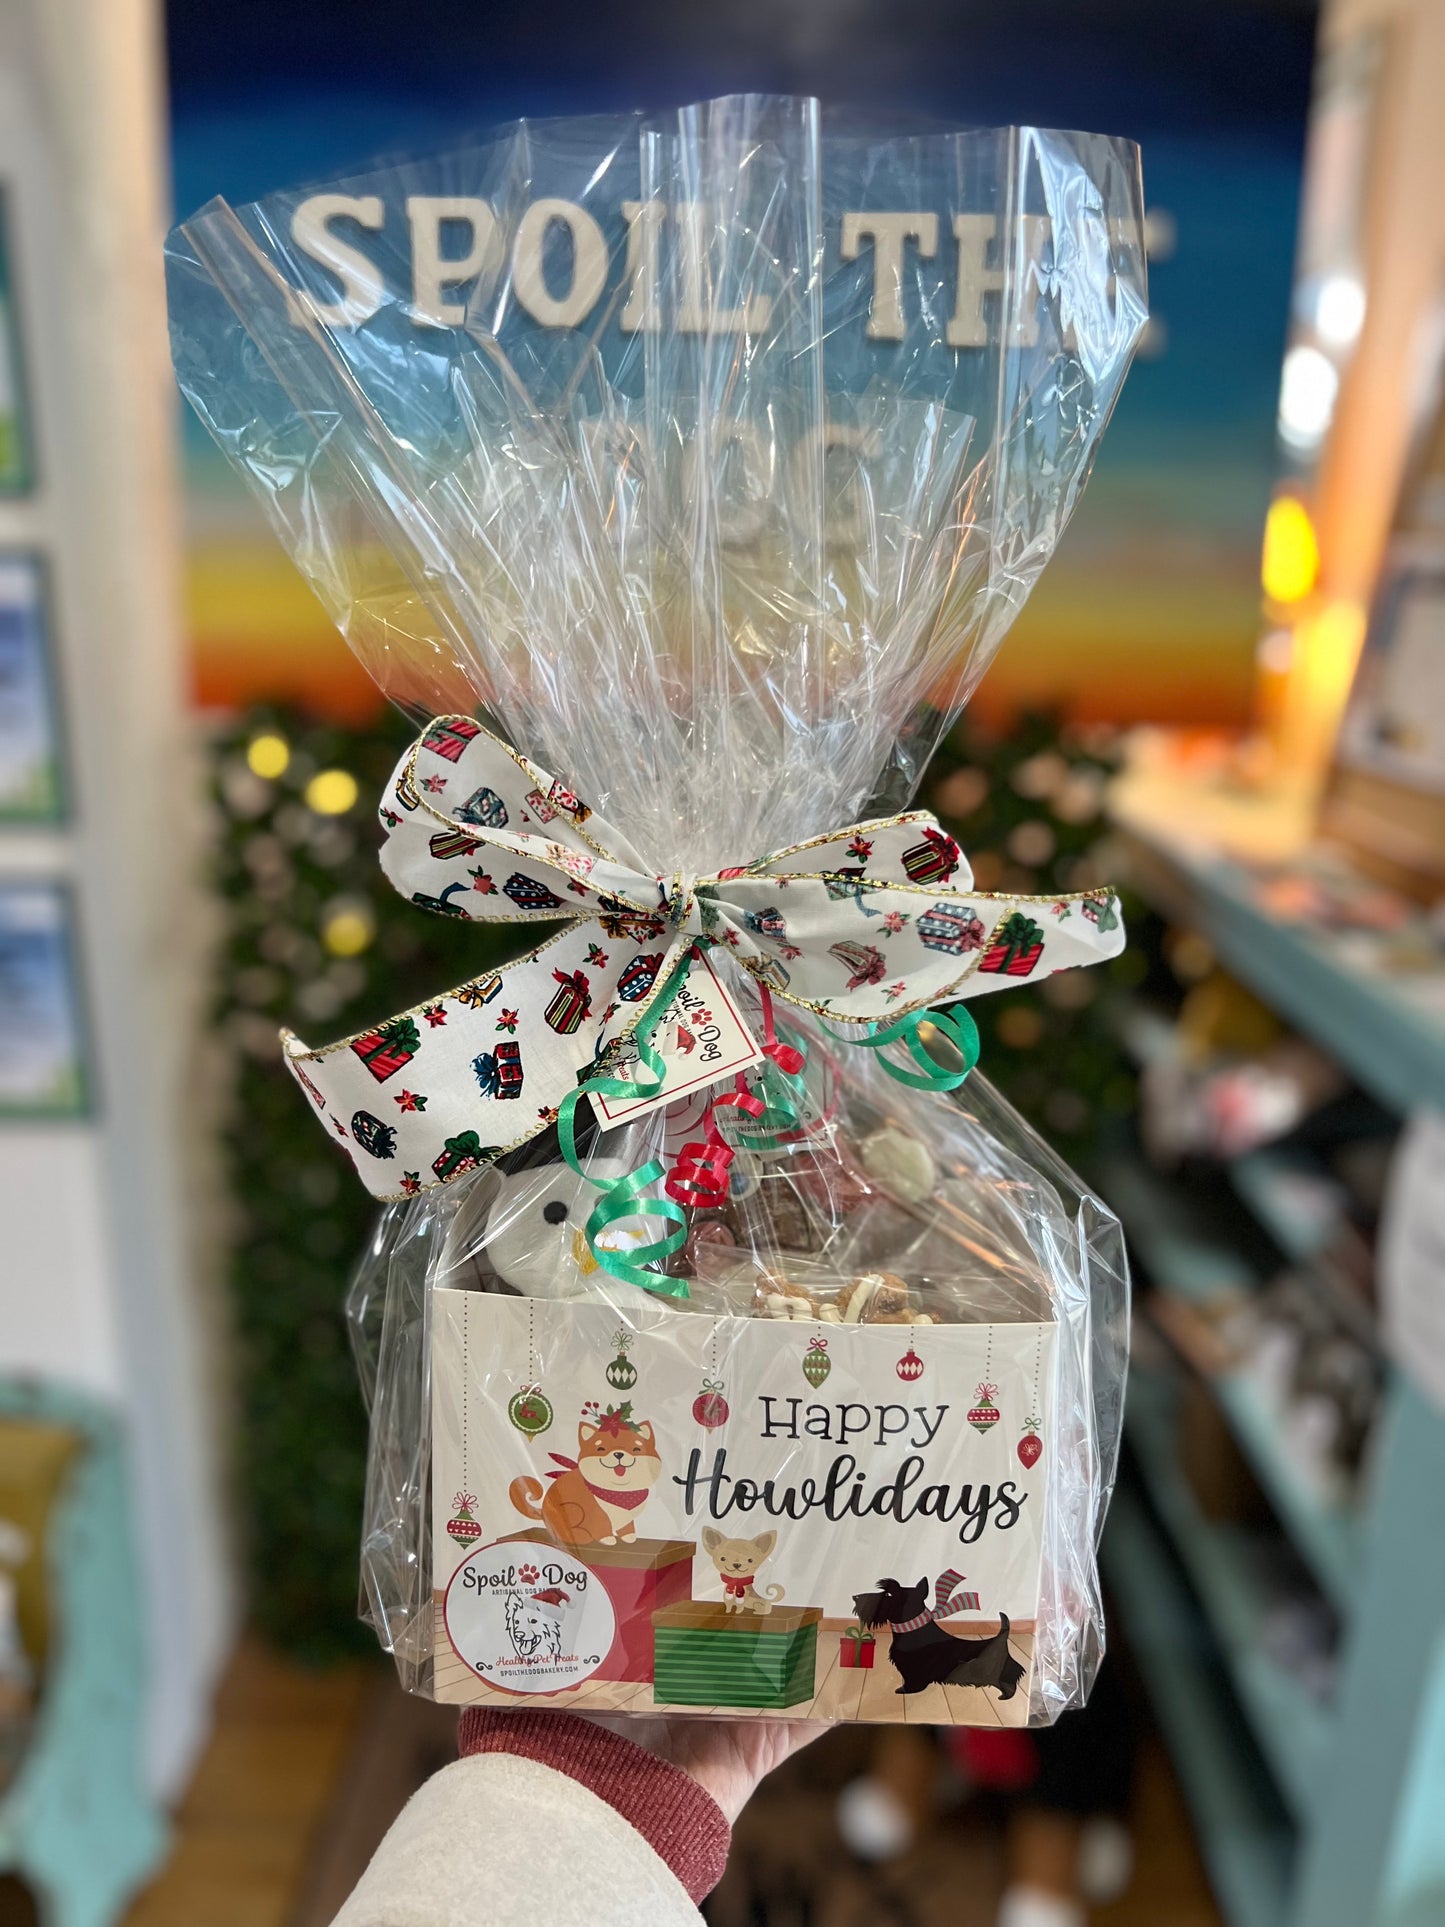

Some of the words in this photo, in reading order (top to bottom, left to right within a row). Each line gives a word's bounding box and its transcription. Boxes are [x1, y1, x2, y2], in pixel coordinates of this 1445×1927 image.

[286, 194, 773, 336] SPOIL
[697, 1025, 722, 1062] Dog
[758, 1395, 950, 1448] Happy
[672, 1447, 1029, 1544] Howlidays
[462, 1565, 517, 1596] Spoil
[542, 1563, 588, 1592] Dog
[495, 1656, 532, 1668] Healthy
[500, 1666, 579, 1676] SPOILTHEDOGBAKERY.COM
